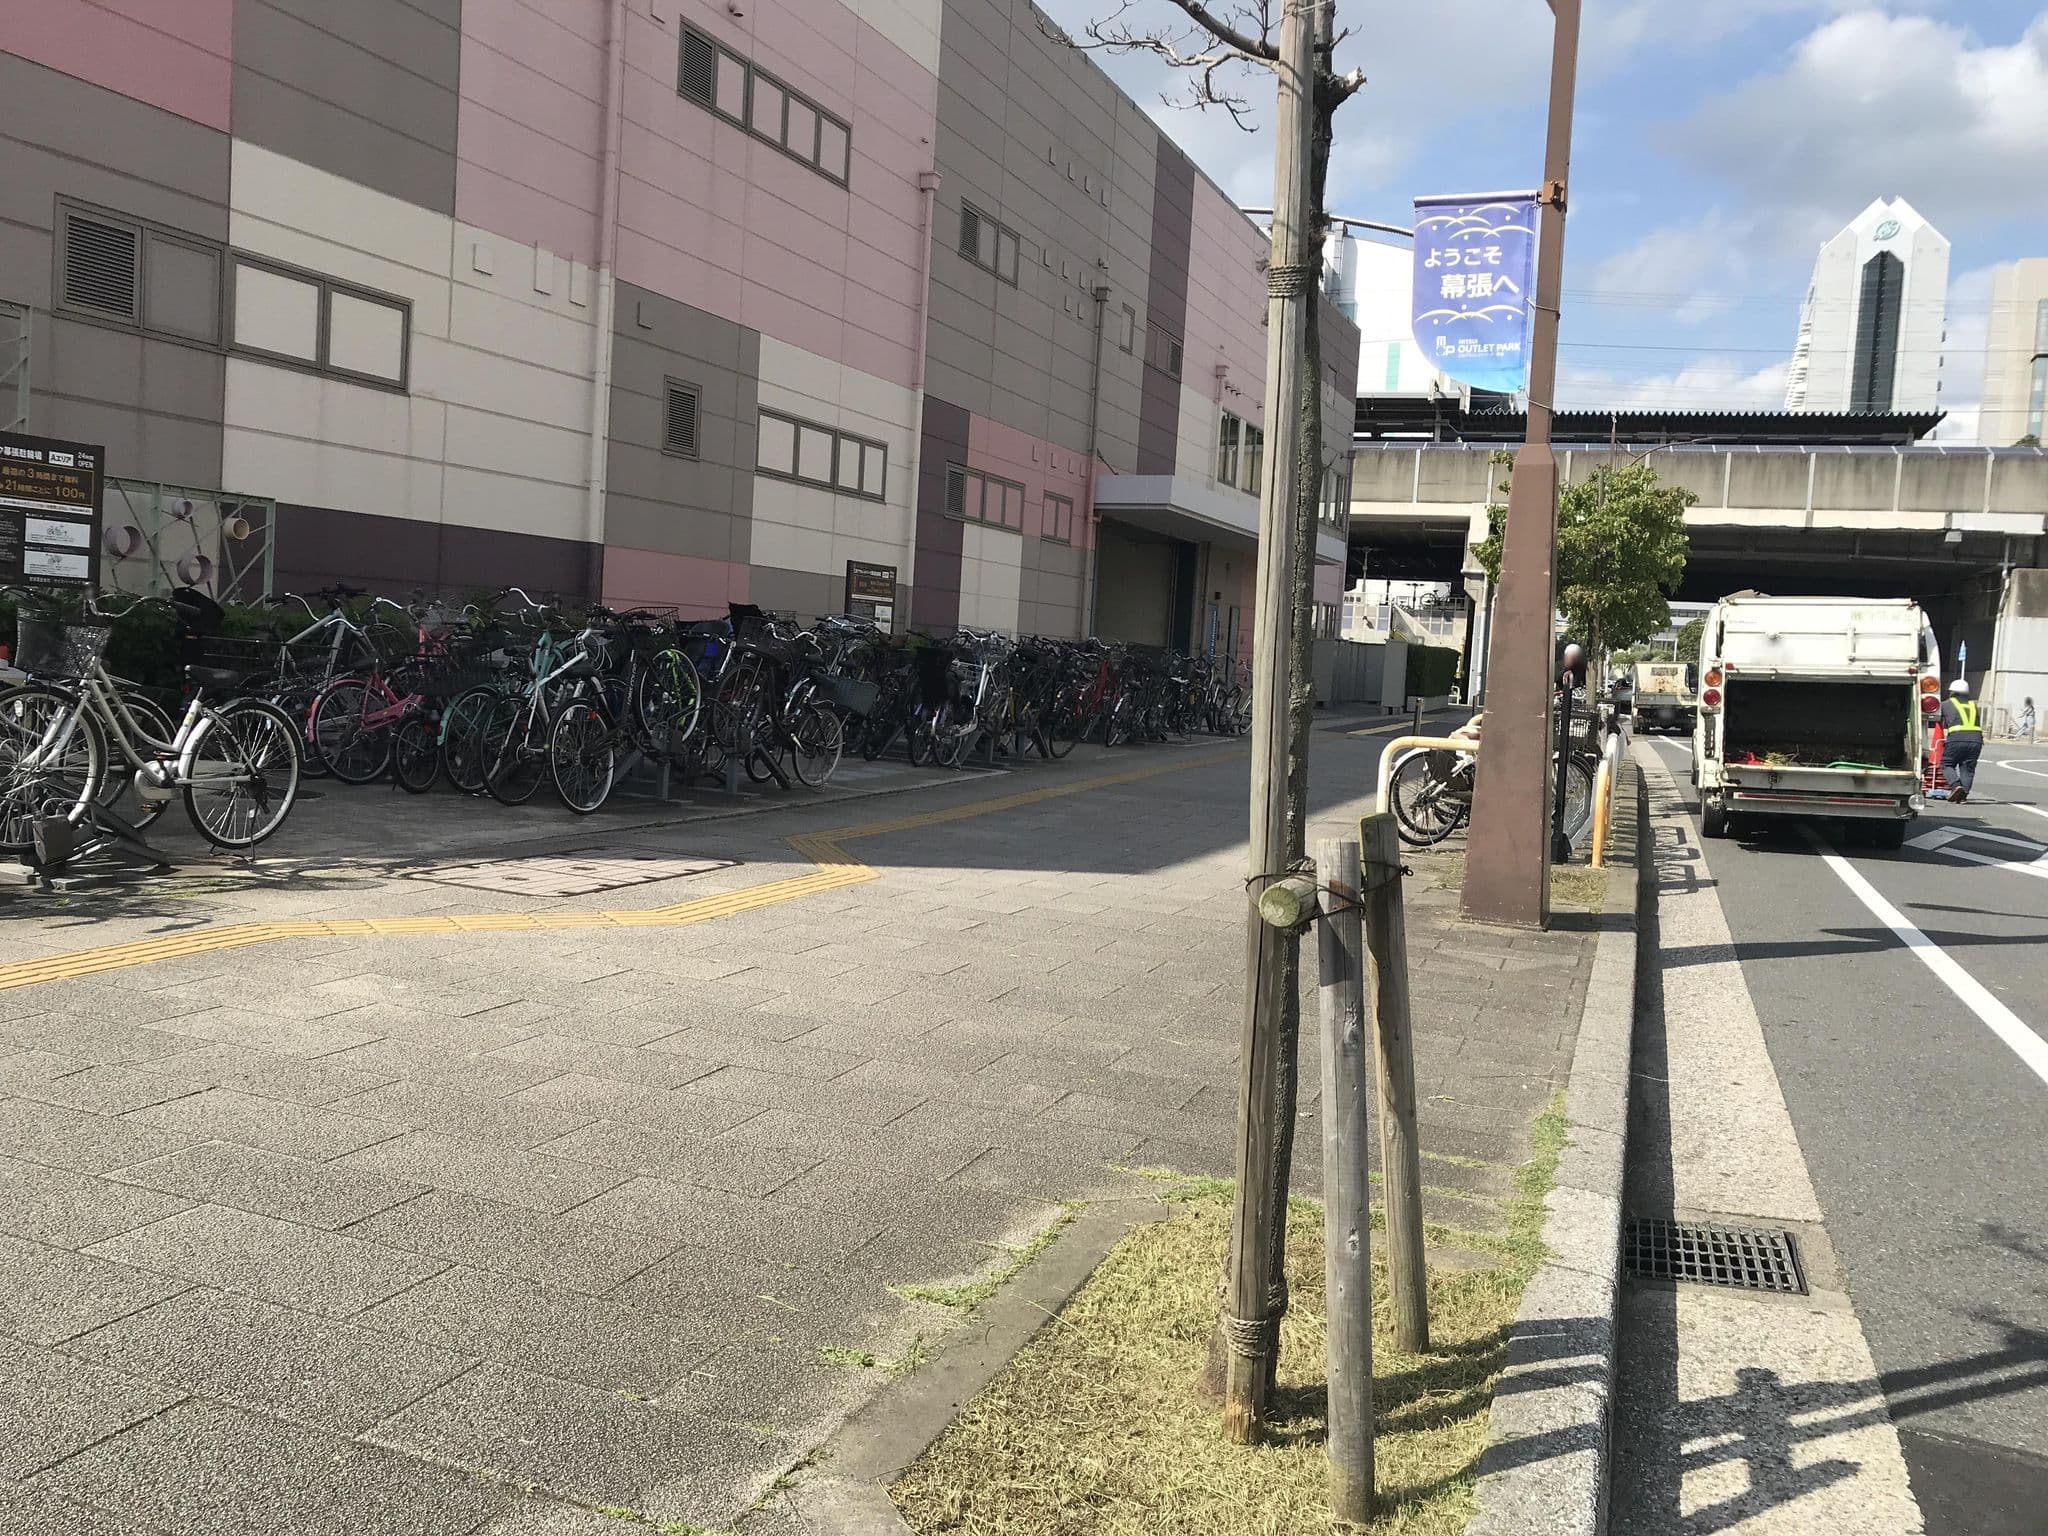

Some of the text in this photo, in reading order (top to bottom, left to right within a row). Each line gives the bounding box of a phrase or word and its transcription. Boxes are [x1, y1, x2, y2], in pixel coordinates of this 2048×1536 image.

[1424, 246, 1502, 267] ようこそ
[1440, 273, 1519, 299] 幕張へ
[1458, 342, 1521, 354] OUTLET PARK
[77, 460, 93, 468] OPEN
